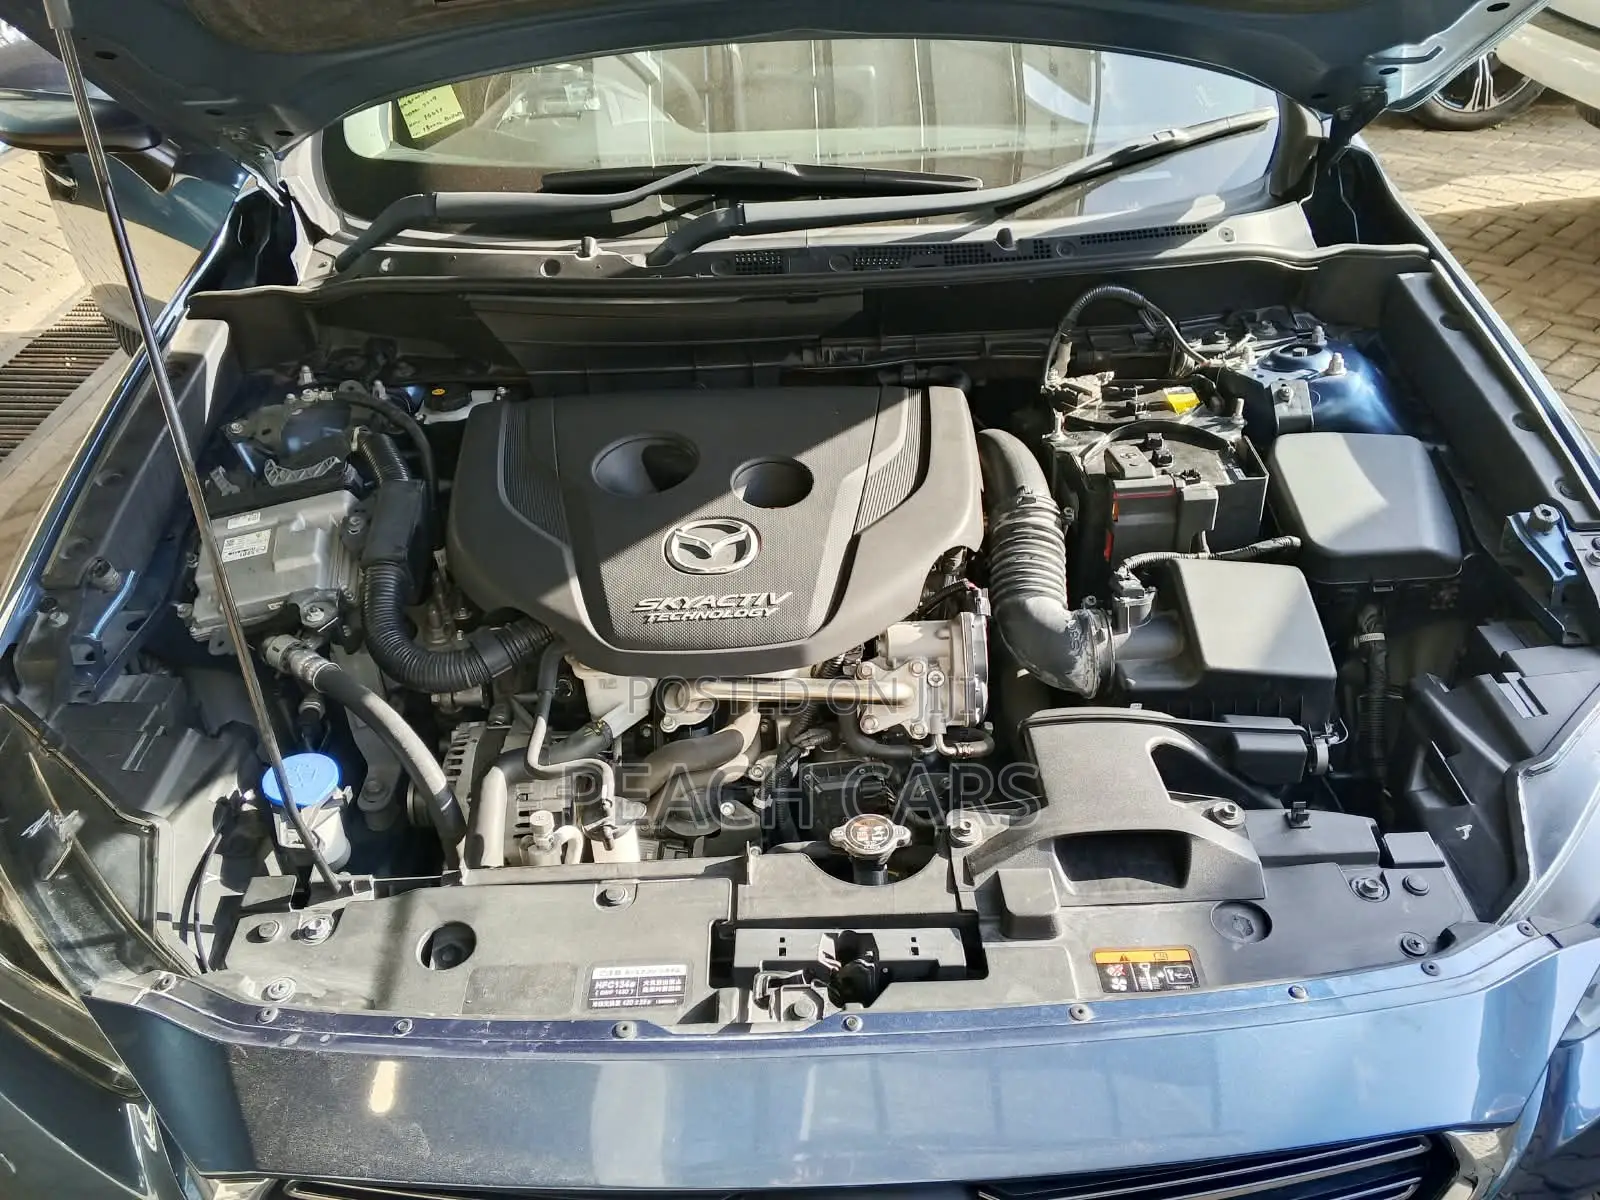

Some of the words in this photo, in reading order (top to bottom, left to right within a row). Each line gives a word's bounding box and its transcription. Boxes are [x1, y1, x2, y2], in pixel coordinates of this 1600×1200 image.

[631, 592, 793, 612] SKYACTIV
[643, 607, 780, 624] TECHNOLOGY
[595, 980, 637, 990] HFC134a
